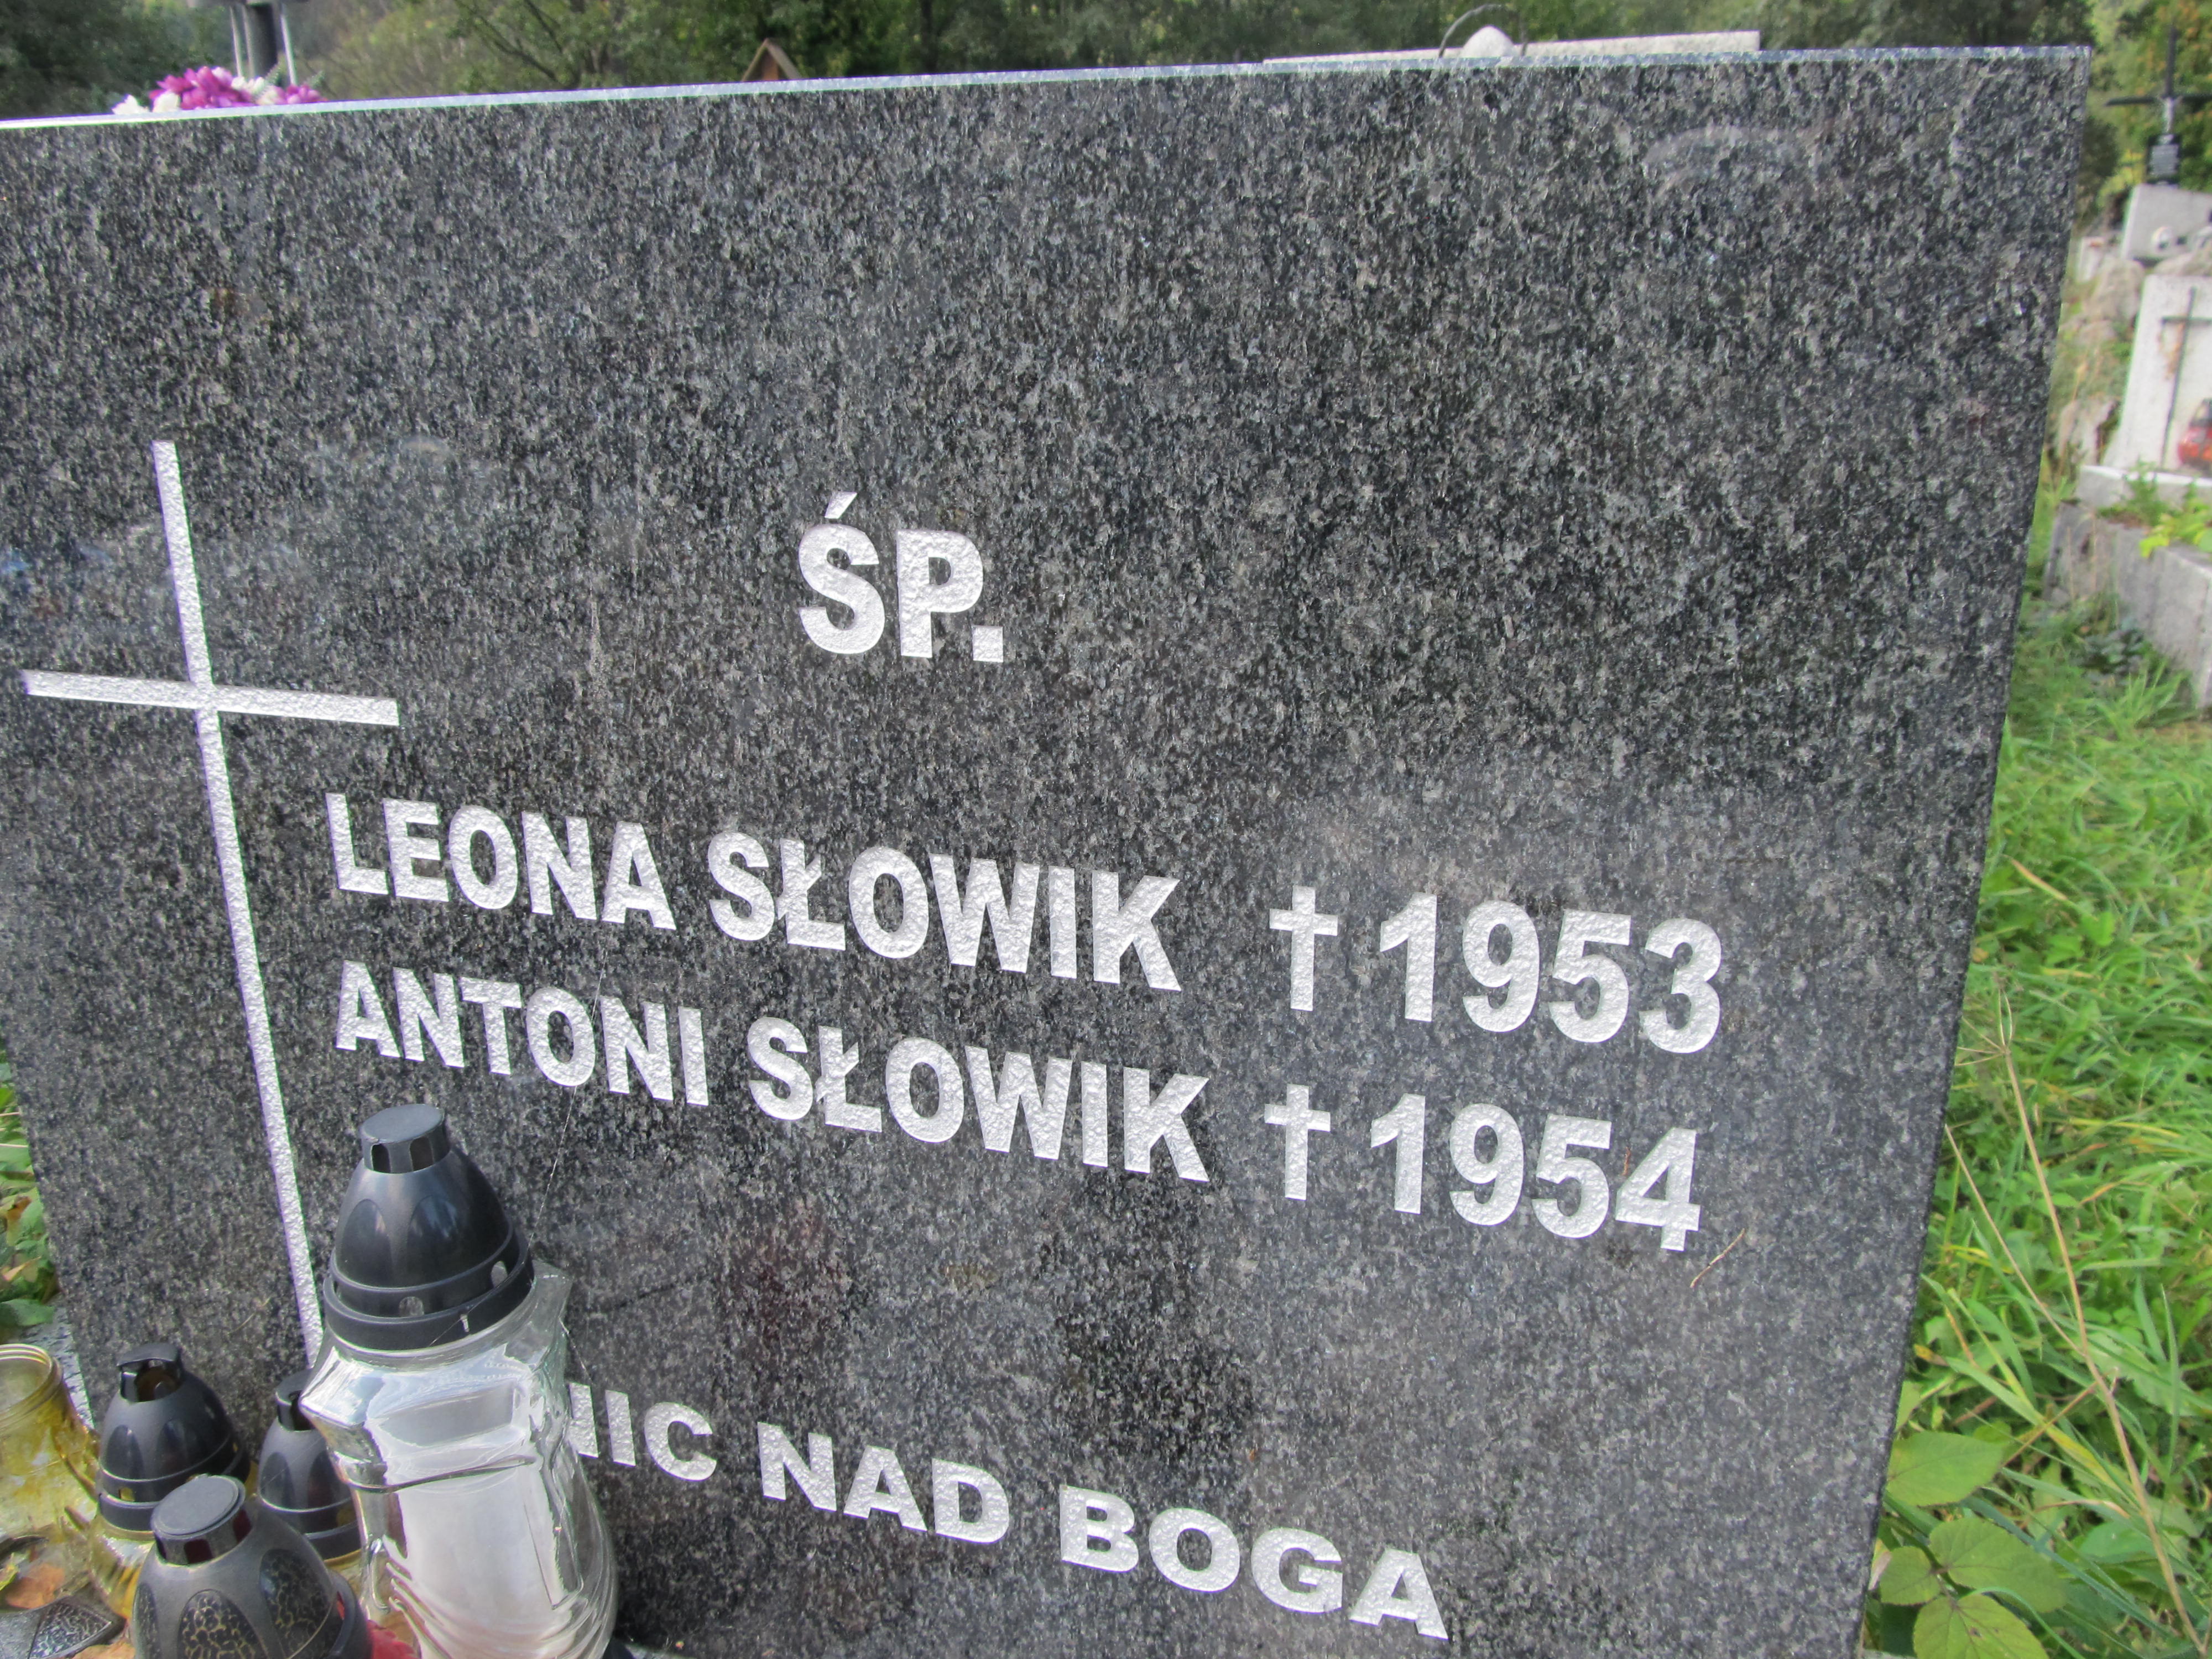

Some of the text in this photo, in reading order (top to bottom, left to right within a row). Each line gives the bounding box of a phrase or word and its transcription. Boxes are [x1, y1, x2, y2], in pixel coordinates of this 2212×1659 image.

[799, 492, 1004, 663] ŚP.
[325, 792, 1723, 1054] LEONA SŁOWIK 1953
[336, 960, 1701, 1251] ANTONI SŁOWIK 1954
[758, 1422, 1009, 1543] NAD
[1060, 1484, 1448, 1640] BOGA
